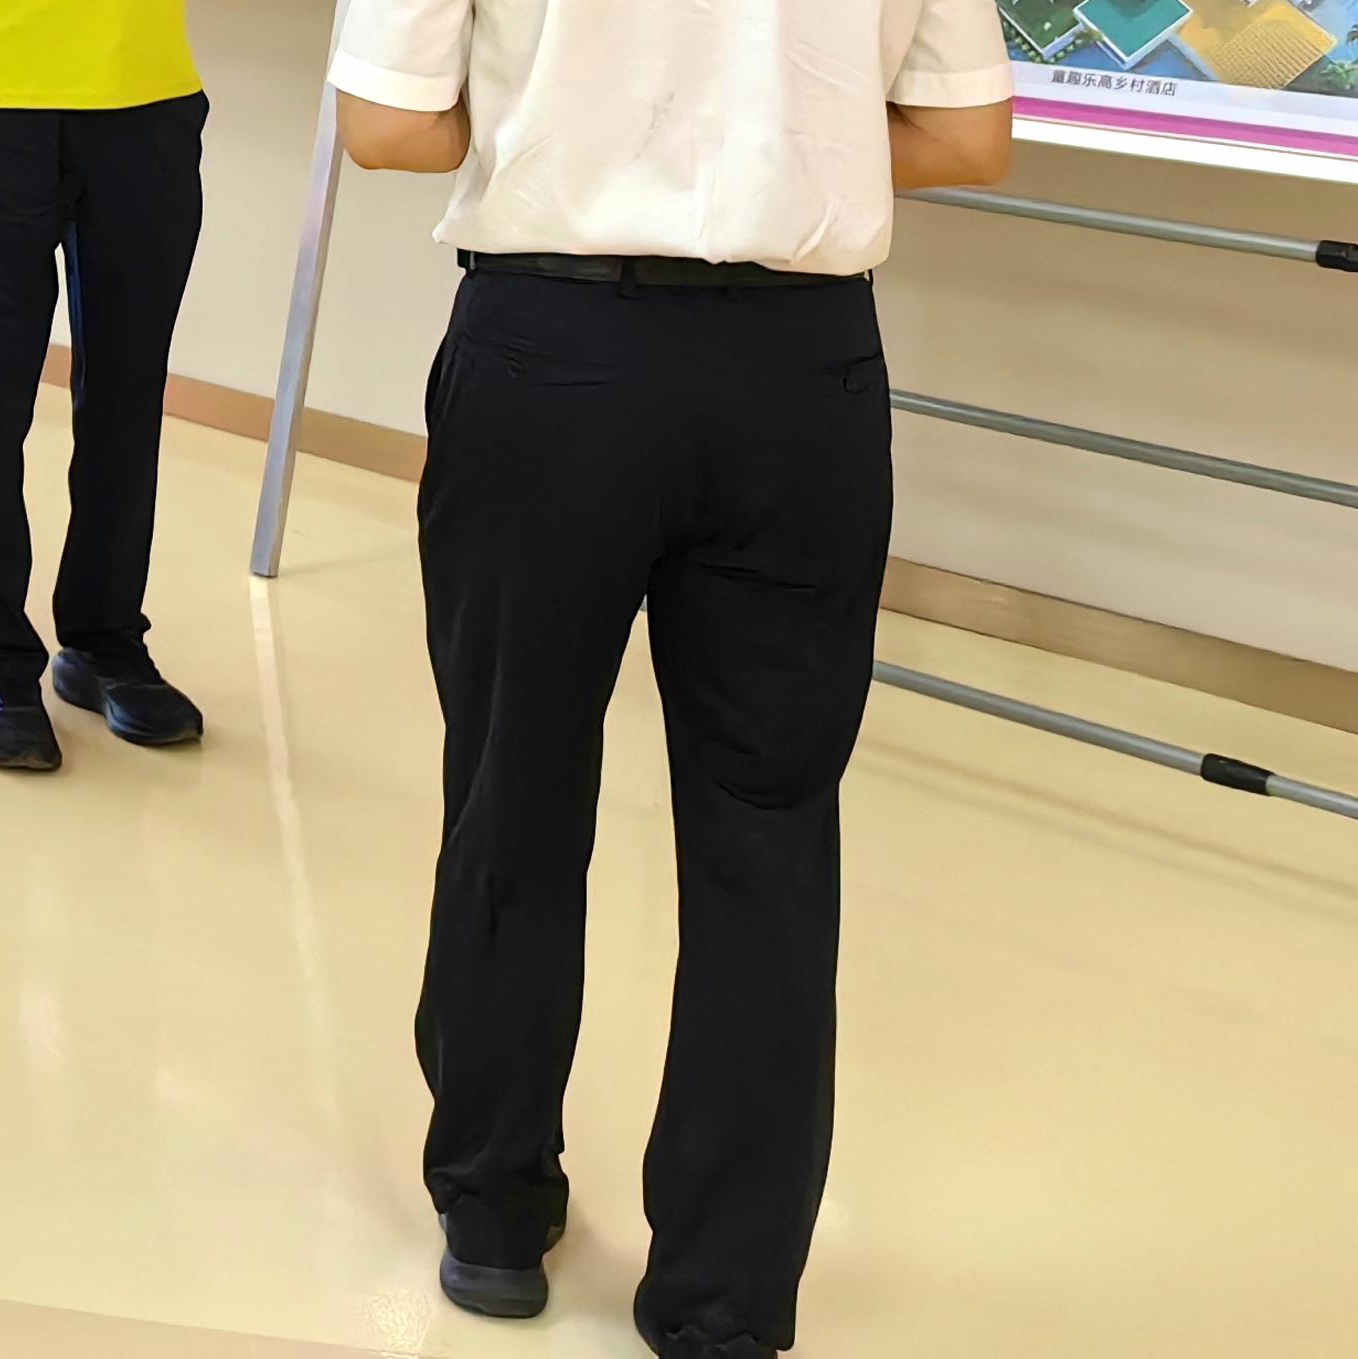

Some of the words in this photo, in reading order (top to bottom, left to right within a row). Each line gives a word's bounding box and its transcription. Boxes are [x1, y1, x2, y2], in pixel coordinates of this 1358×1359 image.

[1051, 69, 1178, 96] 童趣乐高乡村酒店
